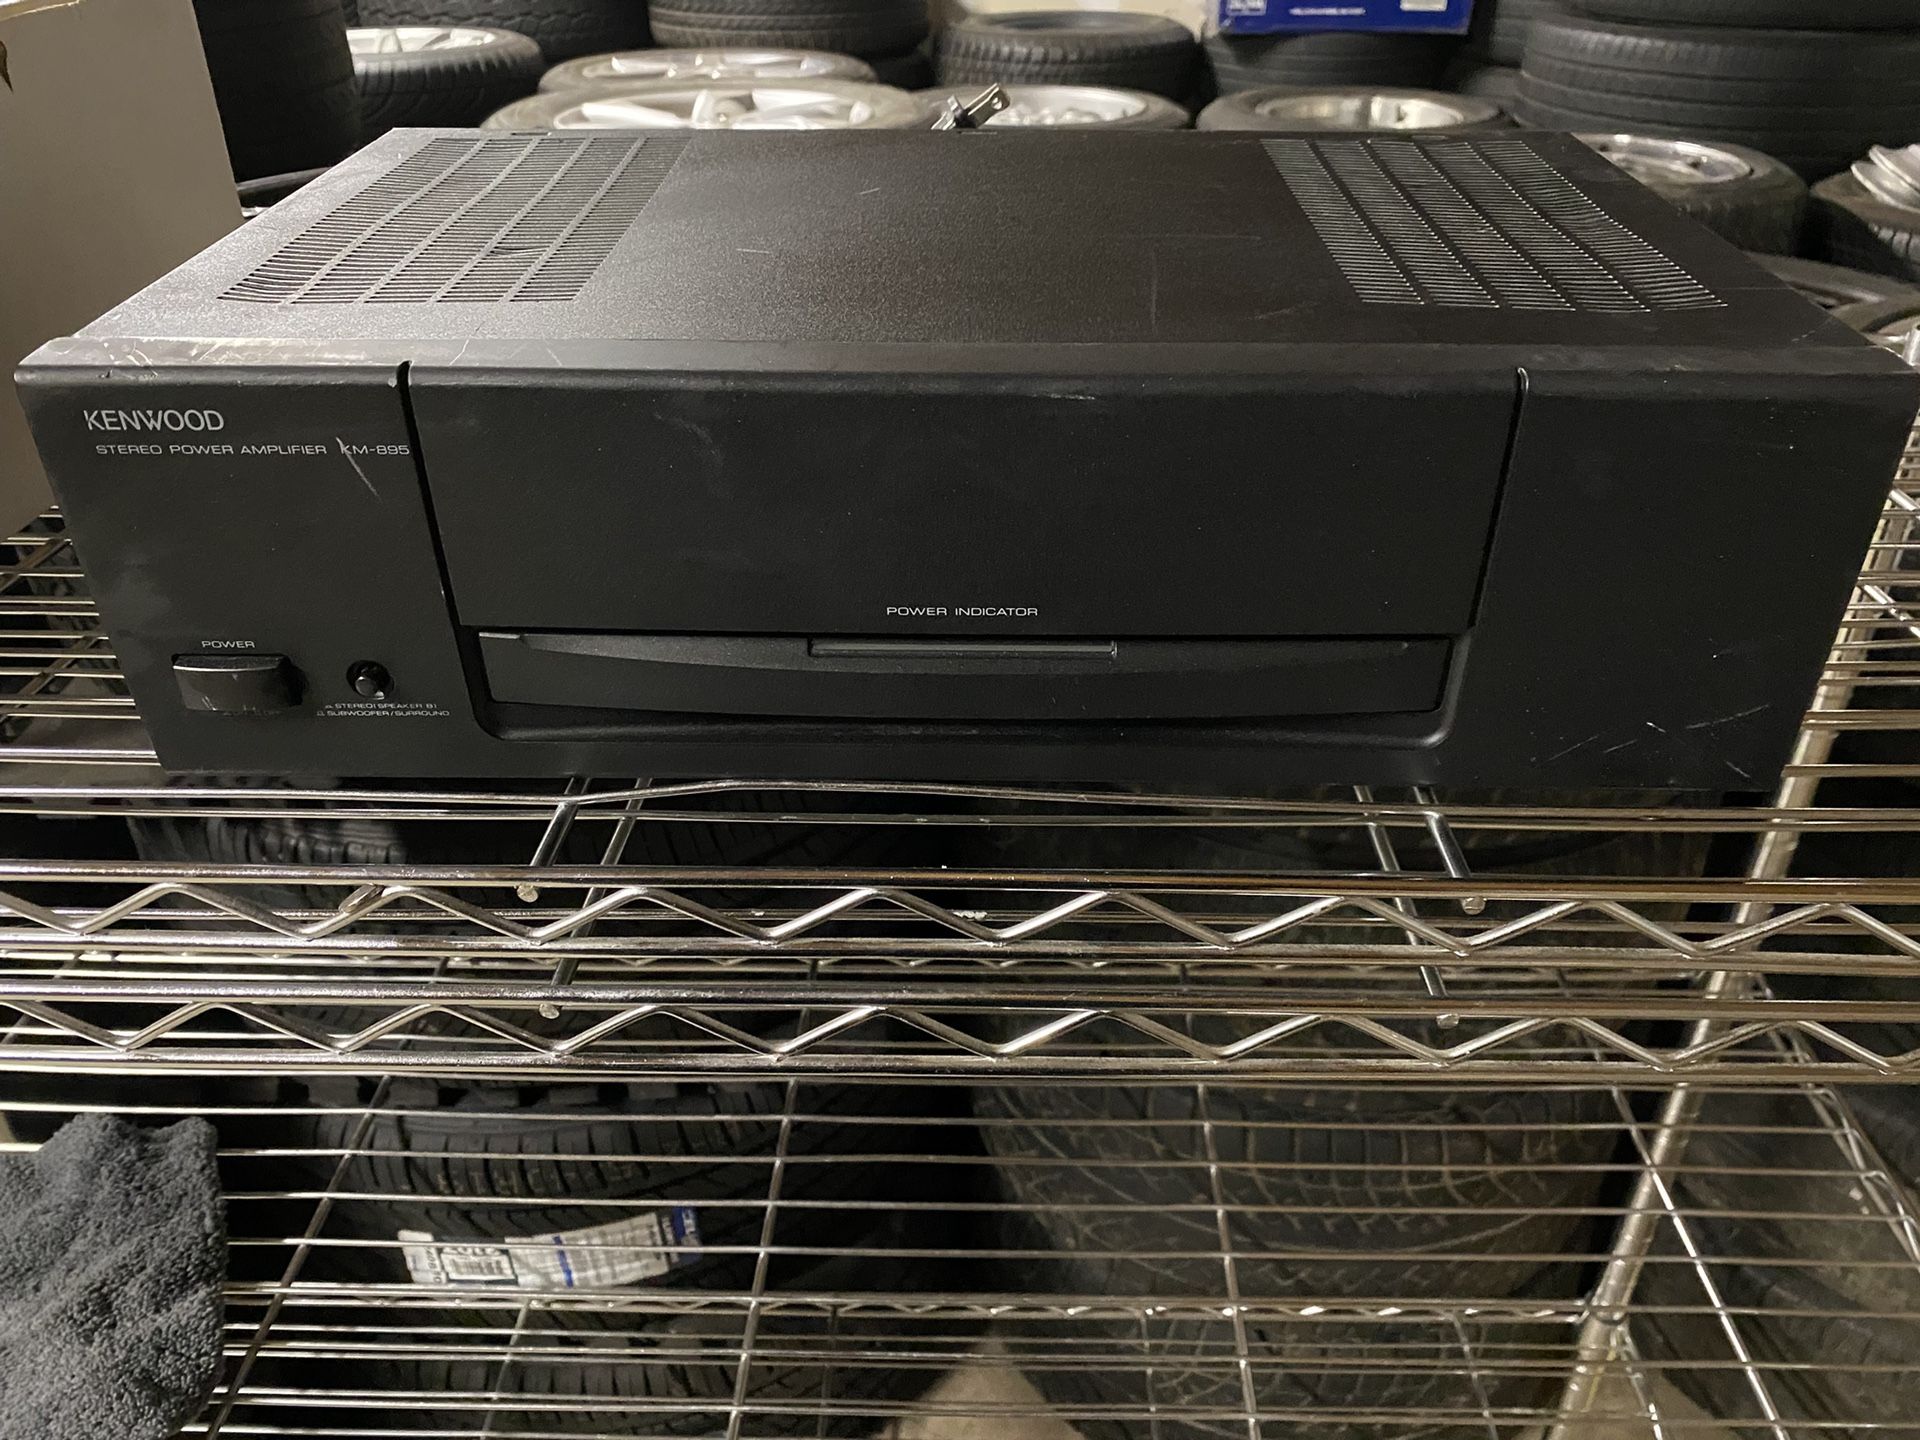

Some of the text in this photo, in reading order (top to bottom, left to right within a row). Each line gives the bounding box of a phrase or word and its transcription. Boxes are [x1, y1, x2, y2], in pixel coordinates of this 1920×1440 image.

[83, 409, 225, 431] KENWOOD
[95, 444, 410, 455] STEREO POWER AMPLIFIER KM-895
[886, 606, 1039, 617] POWER INDICATOR
[201, 640, 256, 649] POWER
